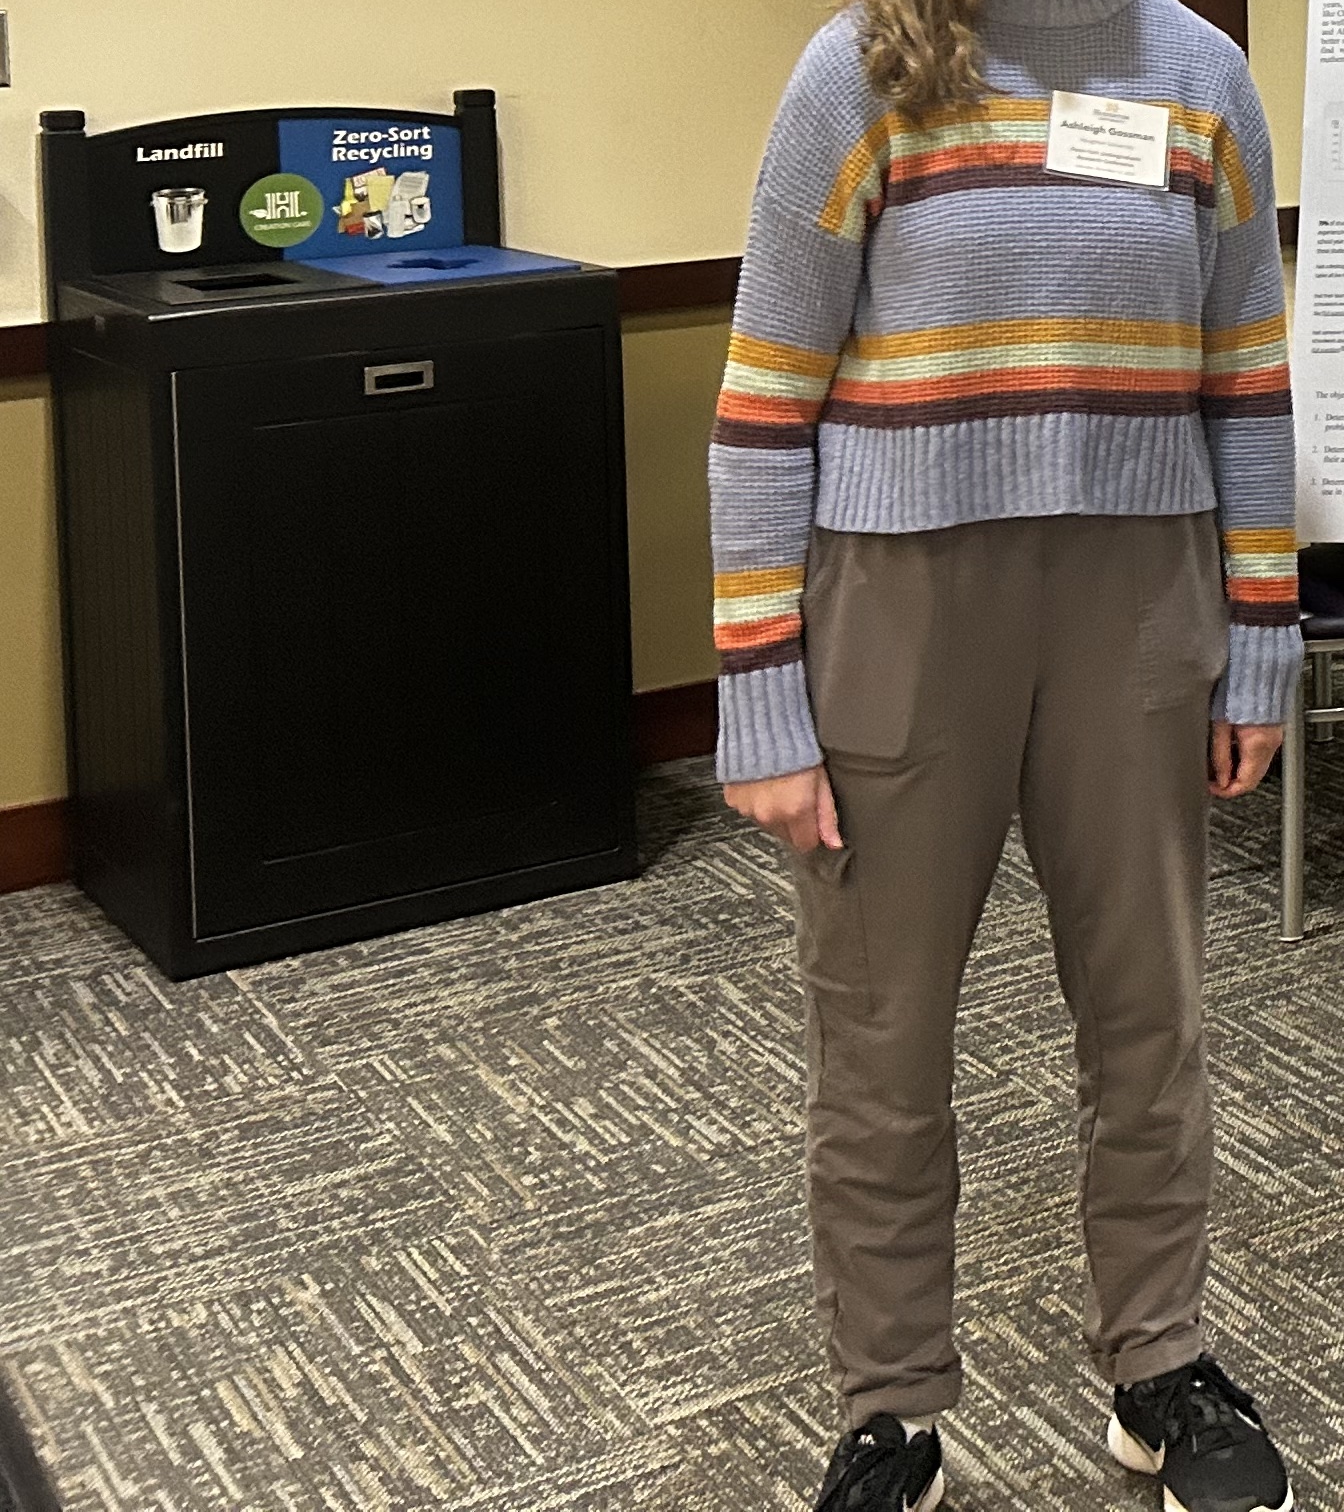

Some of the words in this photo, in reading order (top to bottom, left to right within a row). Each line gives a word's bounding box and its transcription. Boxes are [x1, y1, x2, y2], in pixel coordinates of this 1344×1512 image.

[332, 127, 431, 145] Zero-Sort
[136, 143, 224, 162] Landfill
[332, 143, 433, 164] Recycling
